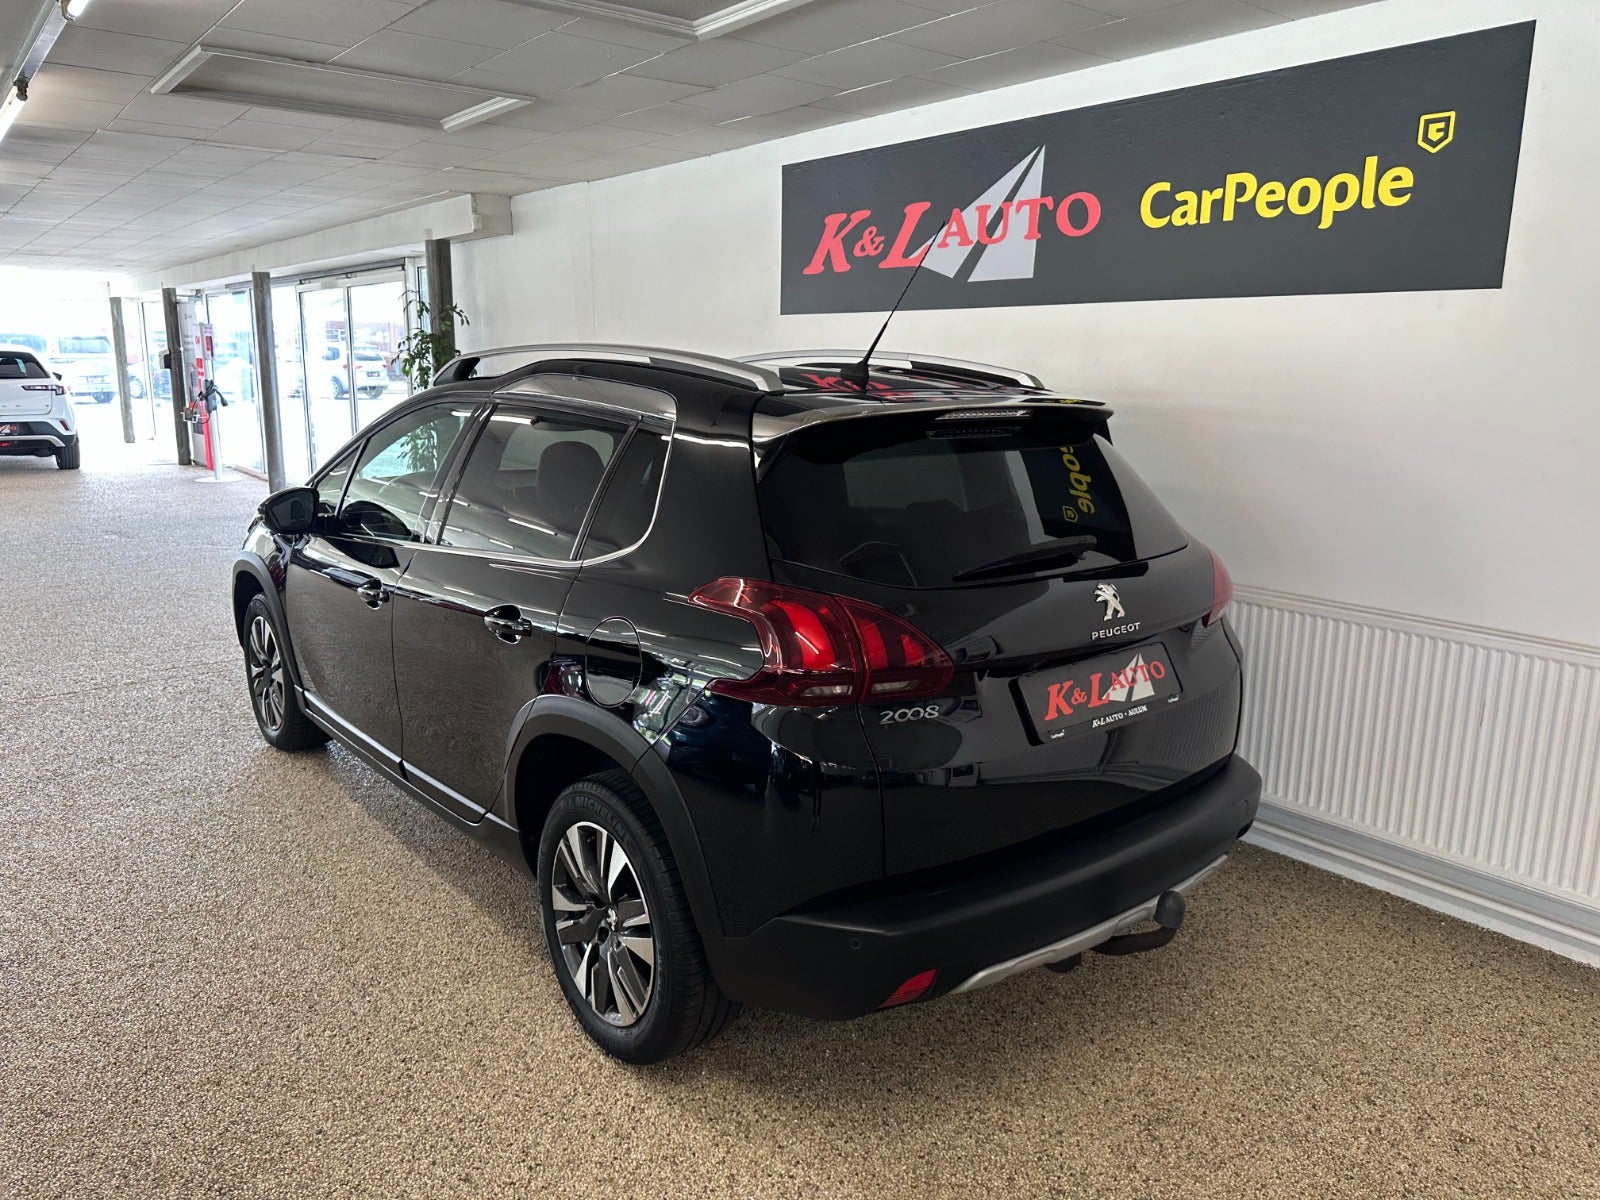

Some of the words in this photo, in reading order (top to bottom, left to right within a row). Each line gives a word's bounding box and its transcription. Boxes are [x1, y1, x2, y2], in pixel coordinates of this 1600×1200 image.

[1140, 155, 1414, 229] CarPeople
[803, 201, 932, 275] K&L
[937, 191, 1101, 249] AUTO
[1091, 621, 1141, 640] PEUGEOT
[1044, 672, 1111, 720] K&L
[1111, 660, 1166, 691] AUTO
[879, 705, 940, 725] 2008
[1105, 712, 1124, 723] AUTO
